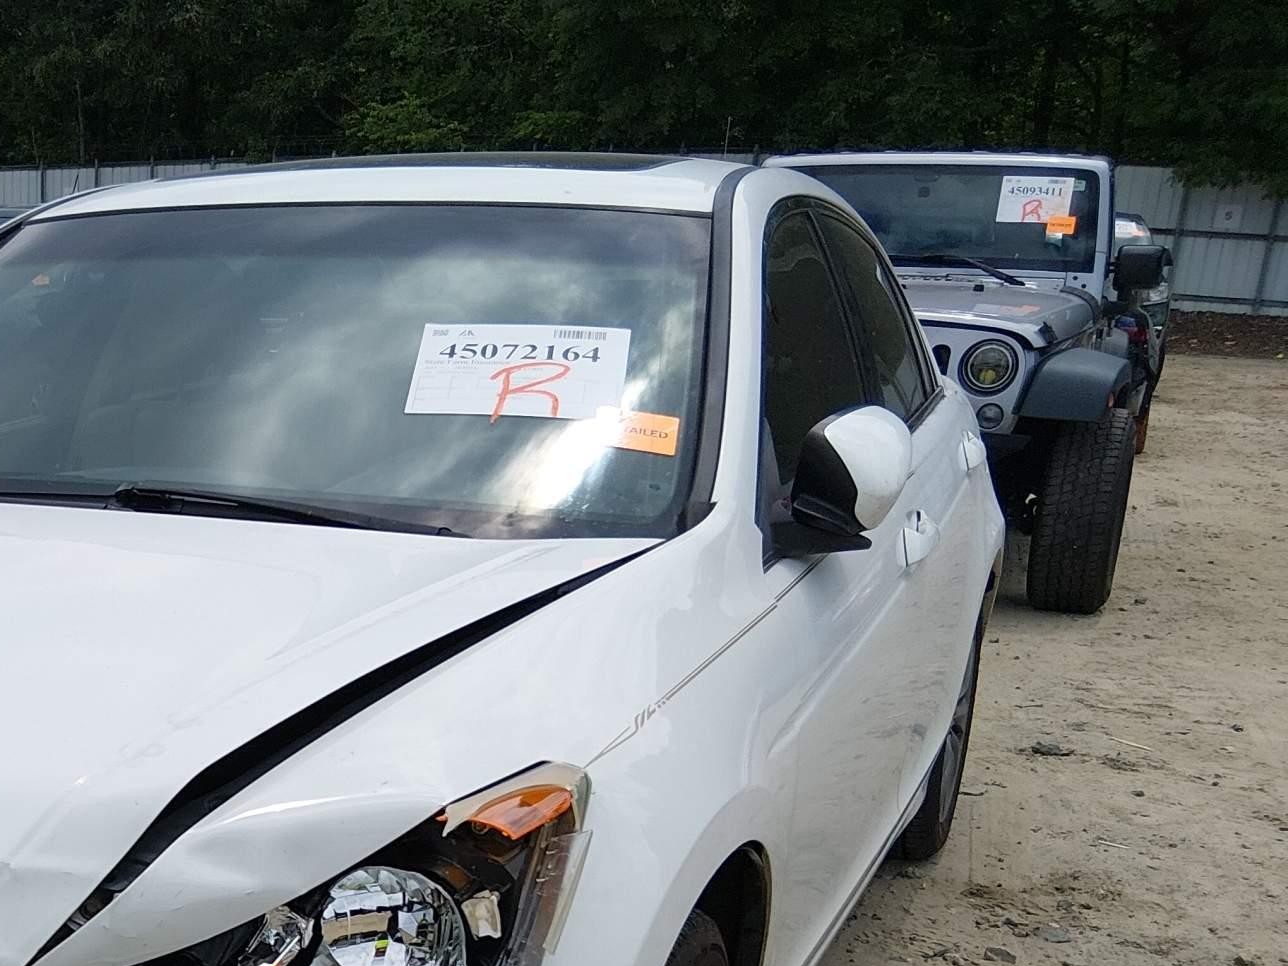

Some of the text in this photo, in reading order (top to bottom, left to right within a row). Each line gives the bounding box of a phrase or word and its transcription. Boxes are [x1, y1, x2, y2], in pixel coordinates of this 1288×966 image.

[1008, 186, 1064, 197] 45093411
[439, 343, 601, 363] 45072164
[489, 362, 570, 424] R
[624, 427, 669, 439] AILED
